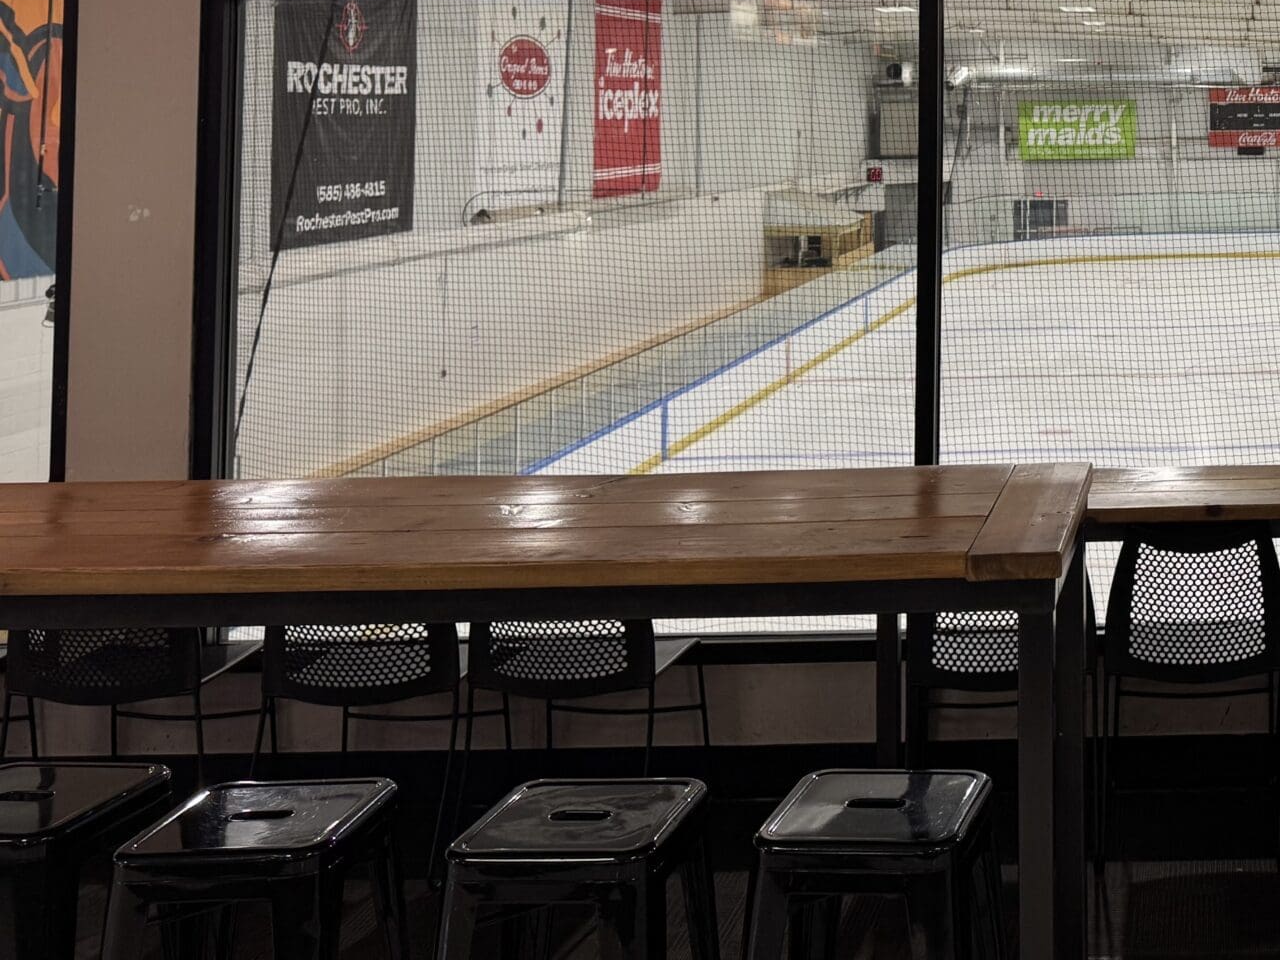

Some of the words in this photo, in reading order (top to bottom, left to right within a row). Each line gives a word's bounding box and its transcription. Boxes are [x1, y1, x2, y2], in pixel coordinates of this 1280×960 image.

[287, 61, 408, 95] ROCHESTER
[312, 98, 336, 115] EST
[599, 76, 659, 134] iceplex
[1032, 104, 1127, 127] merry
[317, 183, 343, 204] (585)
[296, 206, 400, 233] RochesterPestPro.com
